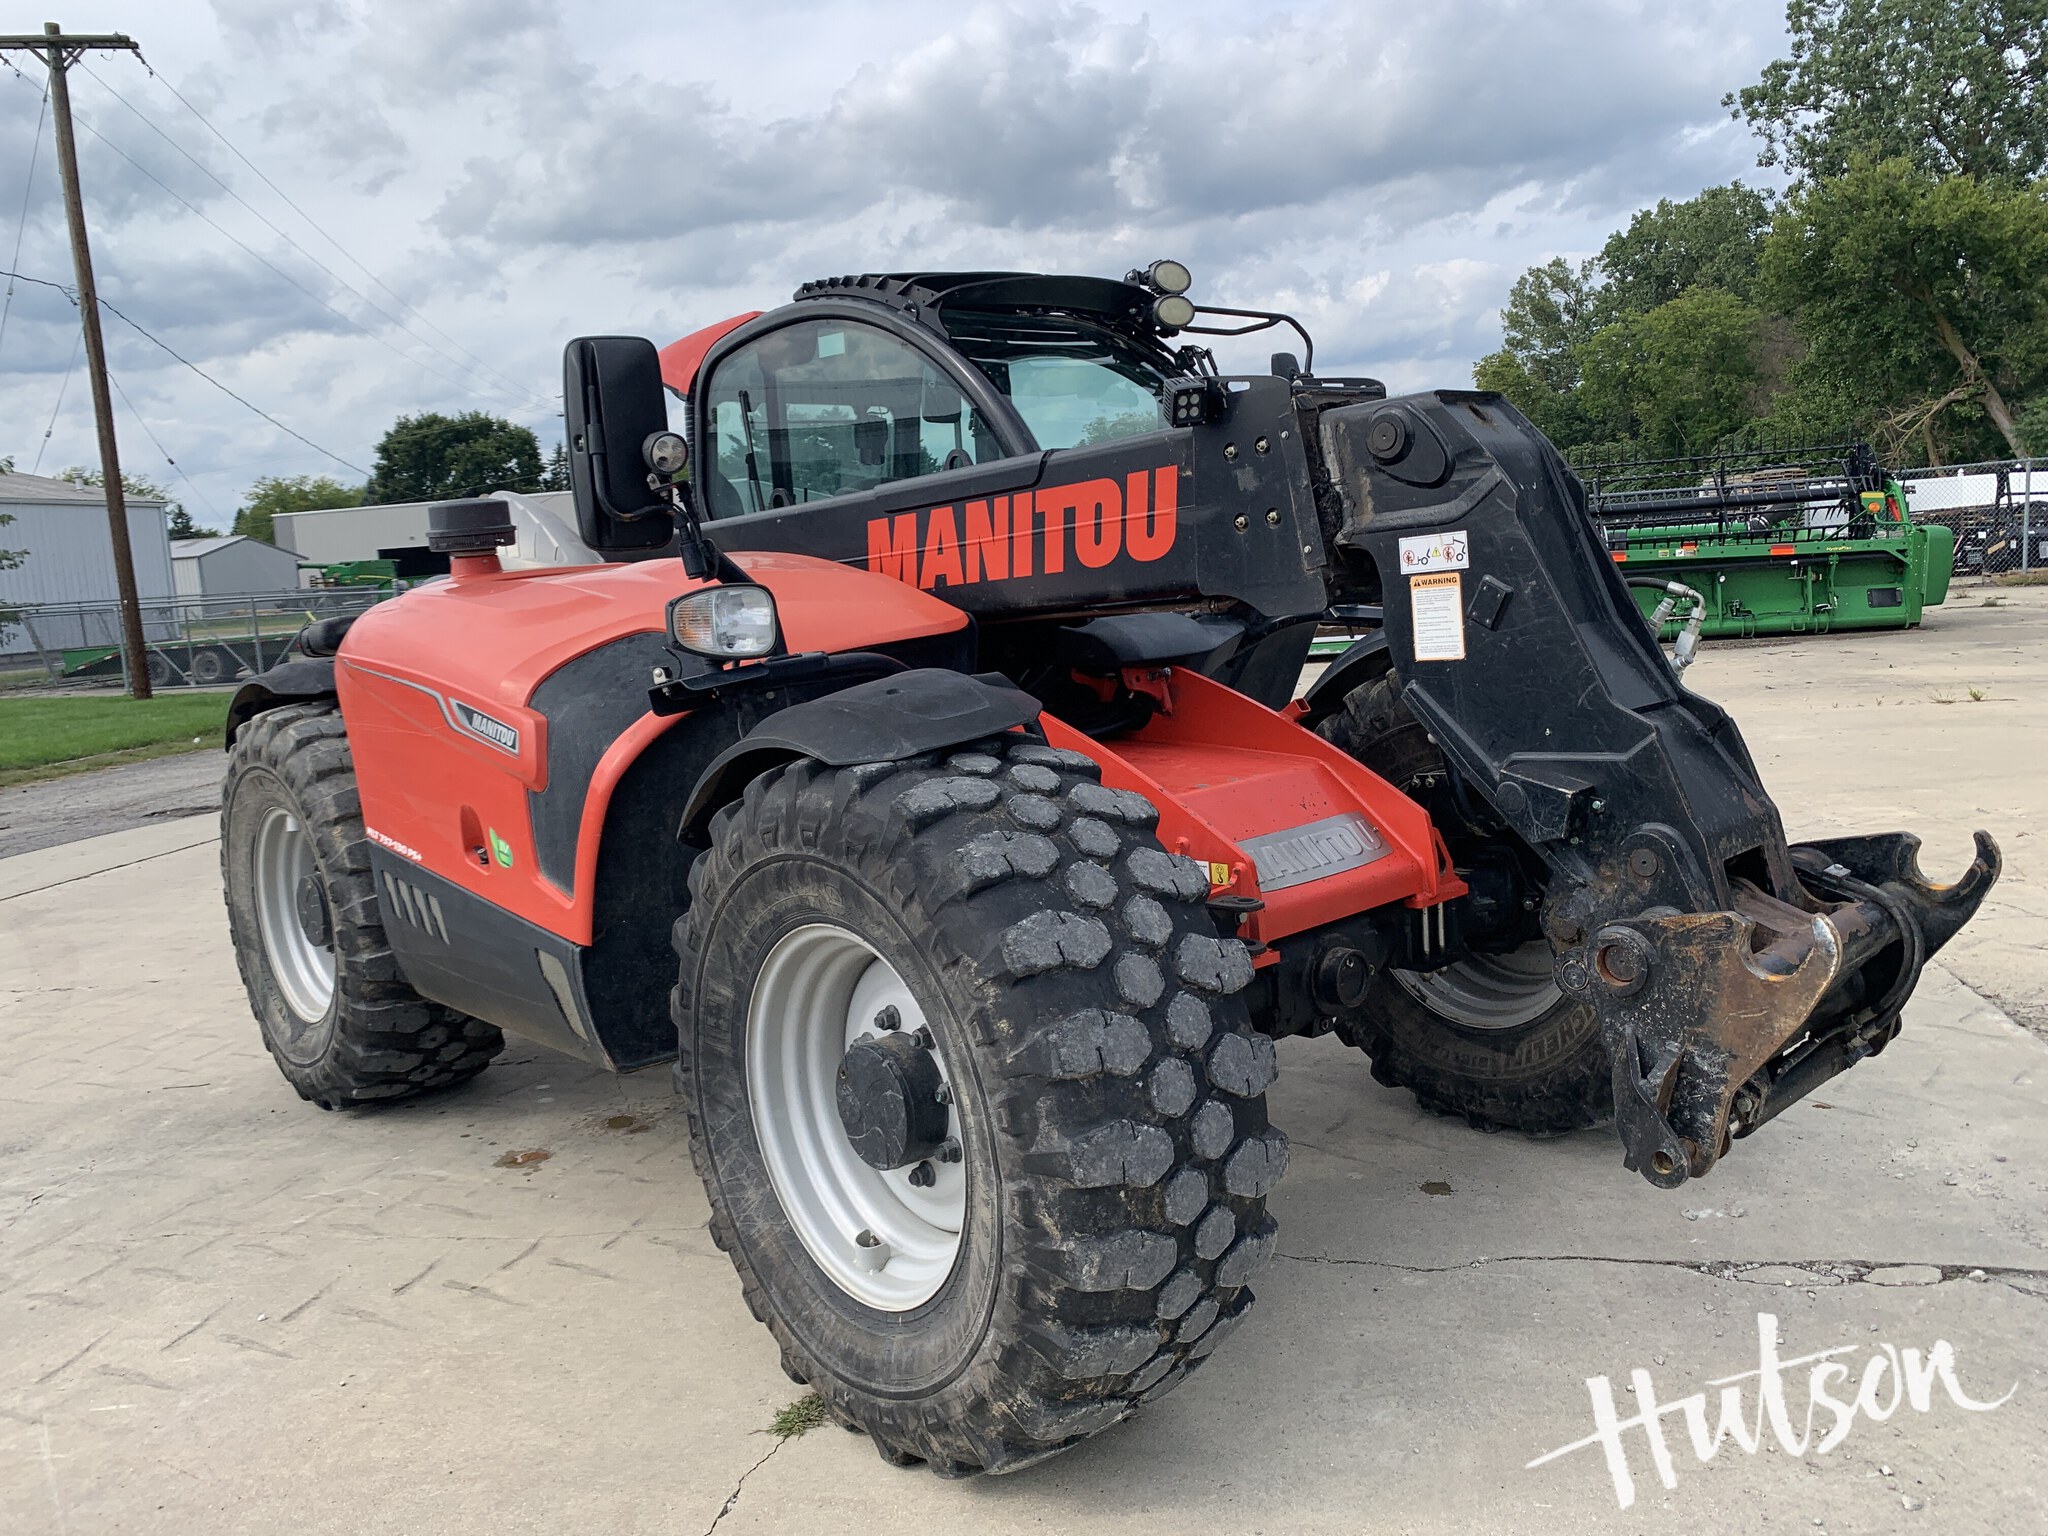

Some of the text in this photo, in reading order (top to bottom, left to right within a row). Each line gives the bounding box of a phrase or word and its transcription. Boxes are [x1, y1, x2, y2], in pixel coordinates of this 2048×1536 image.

[867, 465, 1178, 590] MANITOU
[1420, 577, 1457, 586] WARNING
[471, 713, 515, 746] MANITOU
